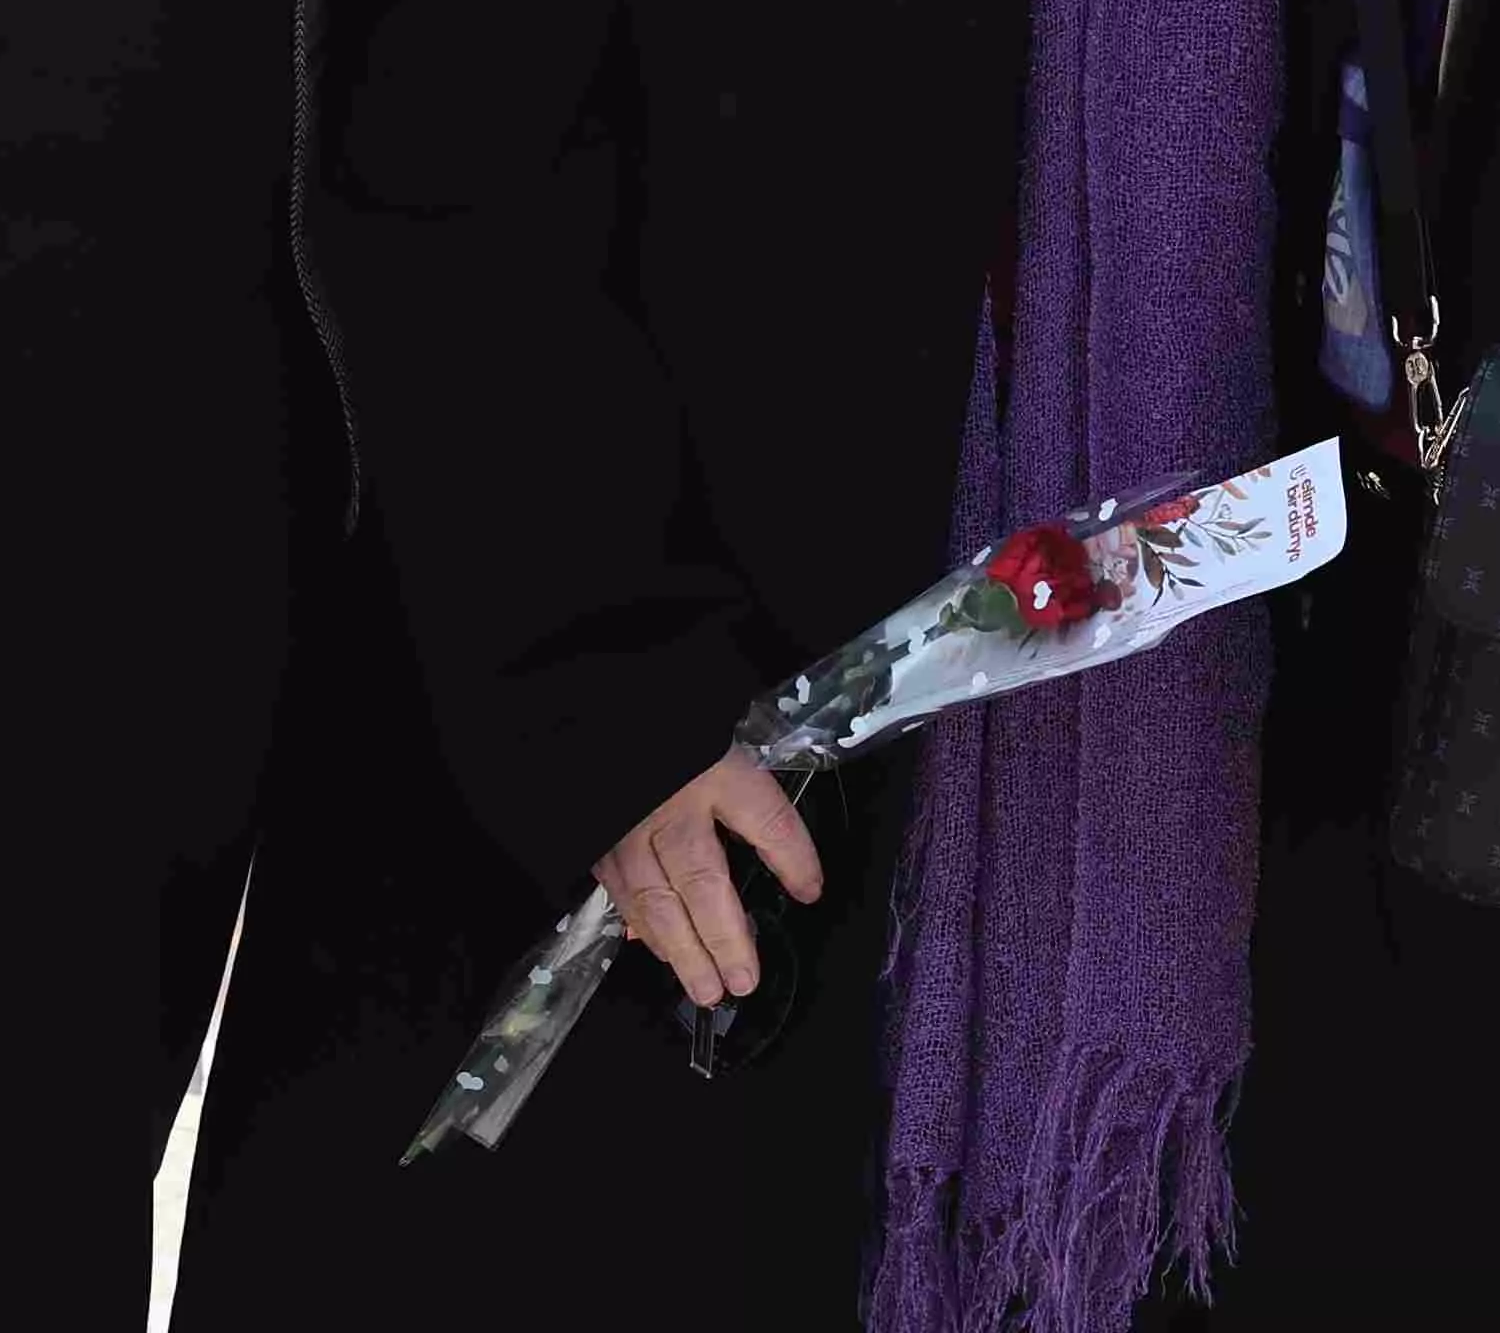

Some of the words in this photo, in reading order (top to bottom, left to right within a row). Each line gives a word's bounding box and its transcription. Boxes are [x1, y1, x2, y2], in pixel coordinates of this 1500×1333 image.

[1286, 483, 1302, 508] bir
[1300, 478, 1320, 539] elimde
[1285, 508, 1303, 564] dünya
